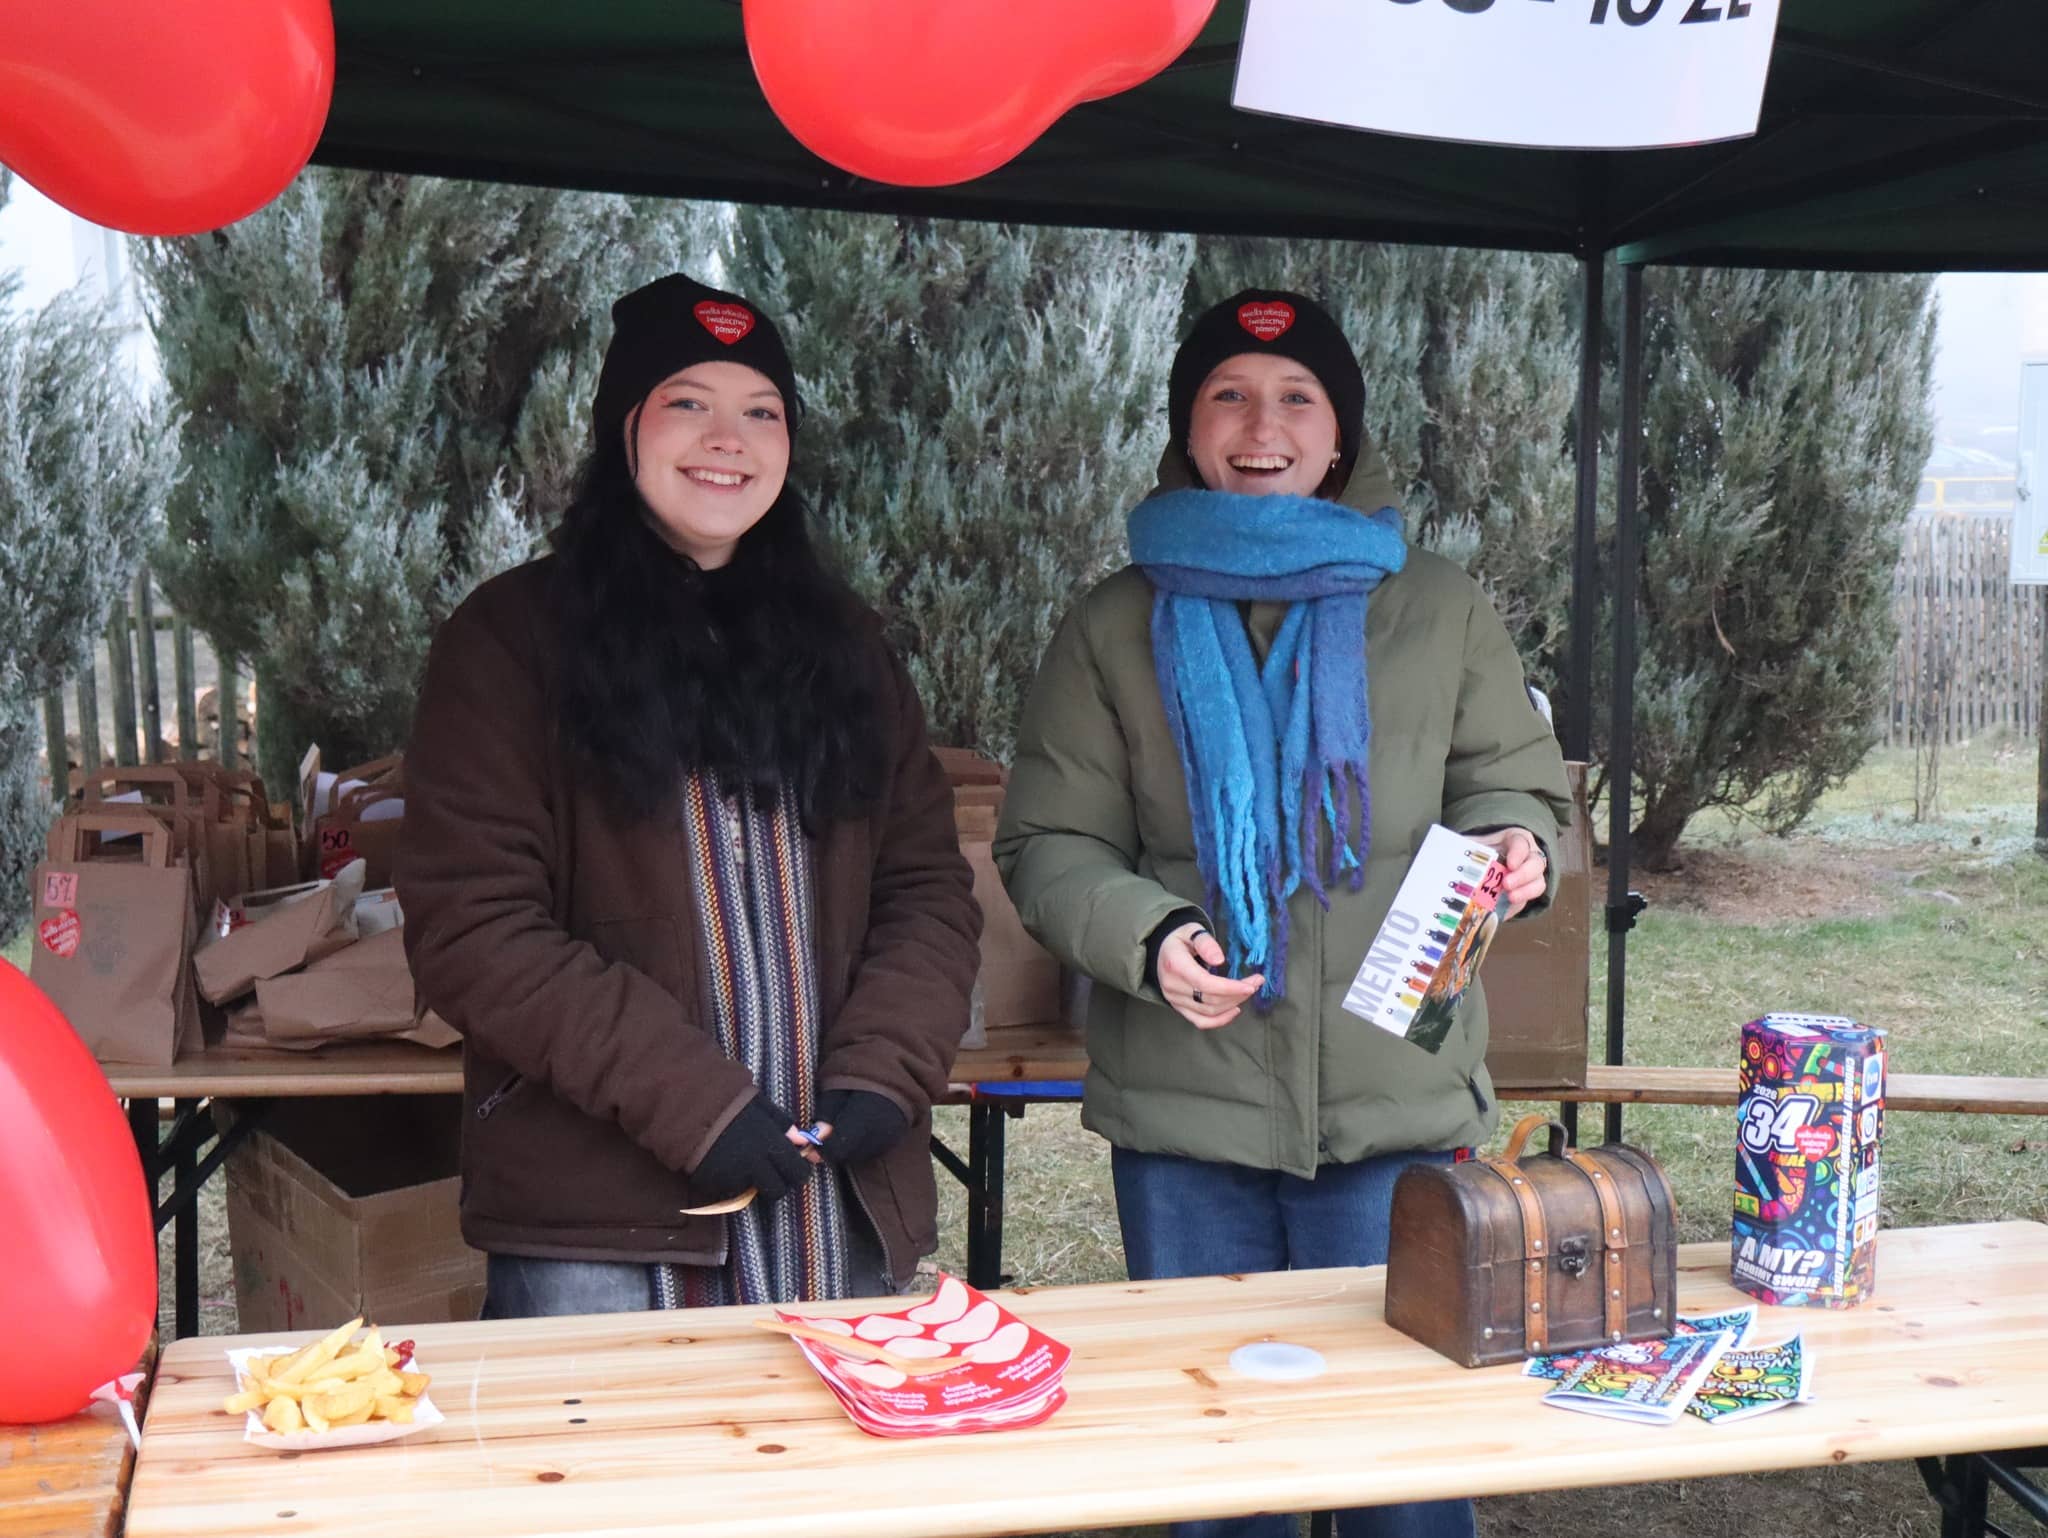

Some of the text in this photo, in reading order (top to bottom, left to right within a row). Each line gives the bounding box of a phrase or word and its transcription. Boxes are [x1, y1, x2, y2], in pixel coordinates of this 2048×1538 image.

[1342, 909, 1421, 1023] MENTO
[1743, 1097, 1816, 1151] 34
[1740, 1235, 1826, 1275] A MY?
[1772, 1273, 1822, 1290] SWOJE
